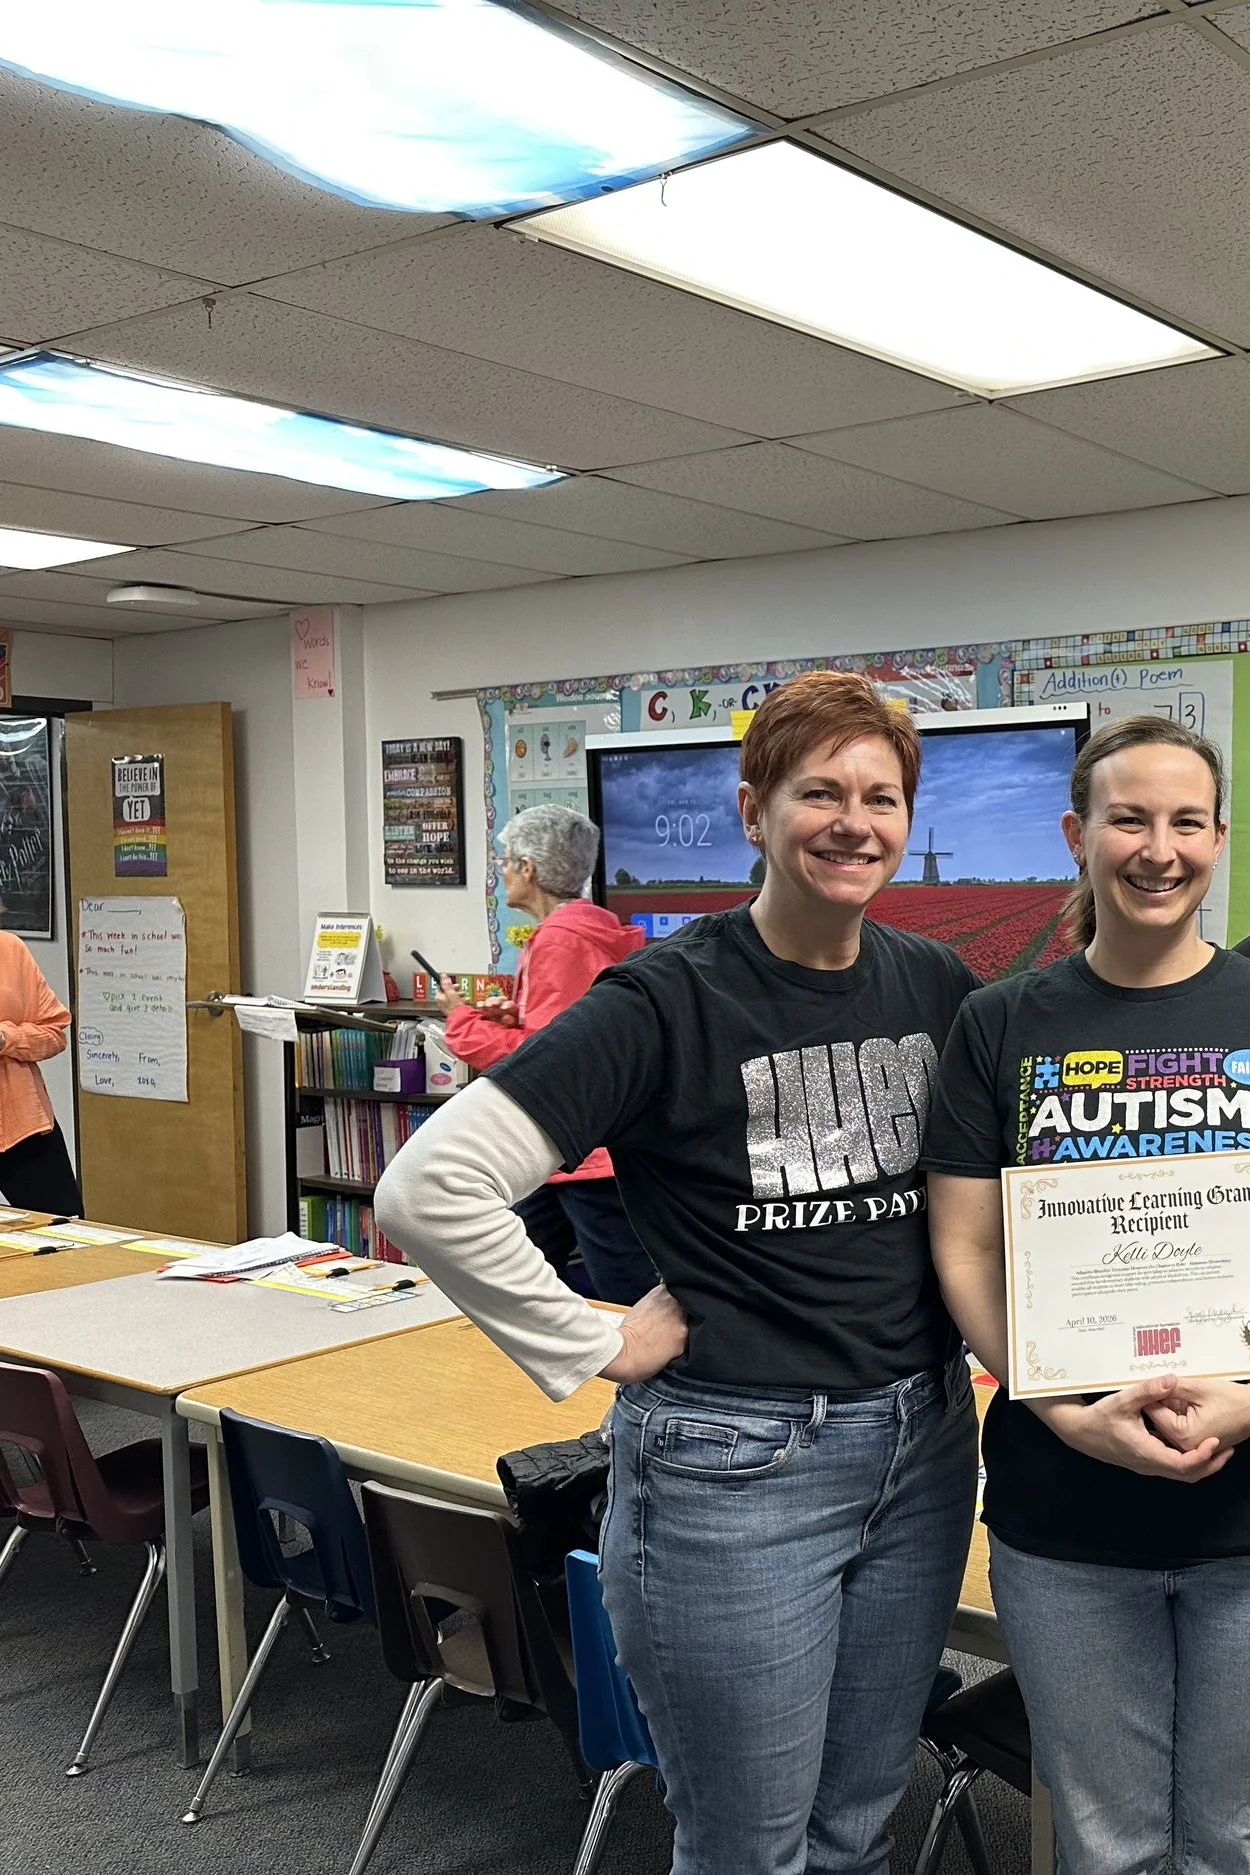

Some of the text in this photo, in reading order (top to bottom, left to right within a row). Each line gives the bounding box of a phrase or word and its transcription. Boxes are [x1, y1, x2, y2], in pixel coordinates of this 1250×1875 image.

[1140, 669, 1182, 685] Poem
[117, 766, 157, 782] BELIEVE IN
[406, 787, 451, 796] COMPASSION
[127, 800, 145, 820] YET
[422, 822, 448, 830] OFFER
[655, 814, 712, 847] 9:02
[422, 832, 450, 842] HOPE
[81, 898, 104, 912] Dear
[131, 931, 138, 940] in
[141, 929, 167, 940] school
[121, 944, 138, 955] fun!
[1065, 1060, 1121, 1077] HOPE
[1128, 1052, 1222, 1075] FIGHT
[1126, 1074, 1226, 1090] STRENGTH
[1015, 1056, 1032, 1165] ACCEPTANCE
[1037, 1193, 1125, 1219] Innovative
[1128, 1187, 1203, 1211] Learning
[734, 1200, 856, 1231] PRIZE
[1110, 1212, 1189, 1236] Recipient
[1102, 1241, 1202, 1264] Kelli Doyle
[1066, 1315, 1117, 1327] April 10, 2026
